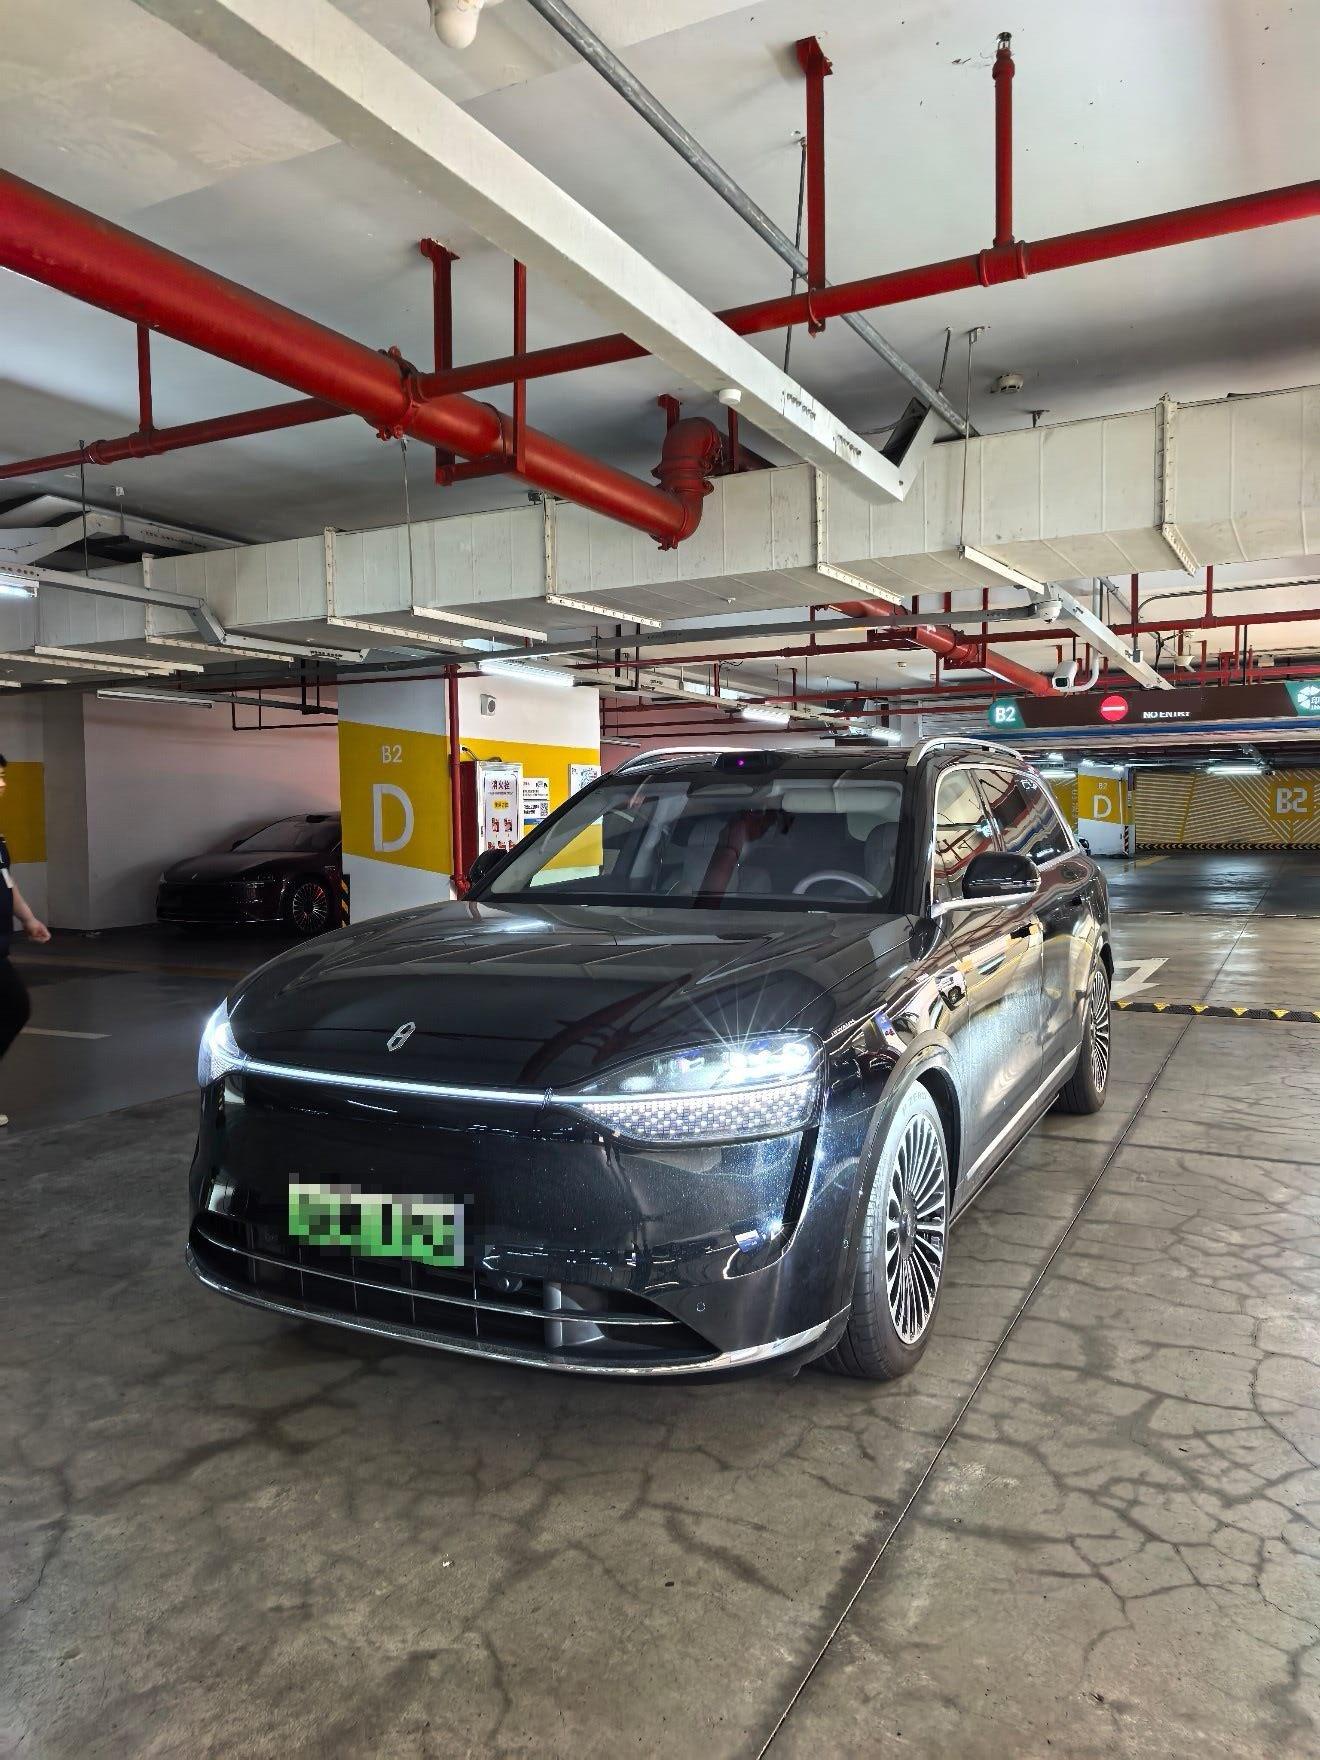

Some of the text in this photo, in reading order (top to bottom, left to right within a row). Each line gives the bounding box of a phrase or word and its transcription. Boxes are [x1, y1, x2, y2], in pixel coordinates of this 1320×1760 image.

[995, 706, 1016, 723] B2
[382, 745, 402, 763] B2
[1093, 794, 1112, 819] D
[1276, 787, 1308, 814] B2
[372, 783, 415, 852] D
